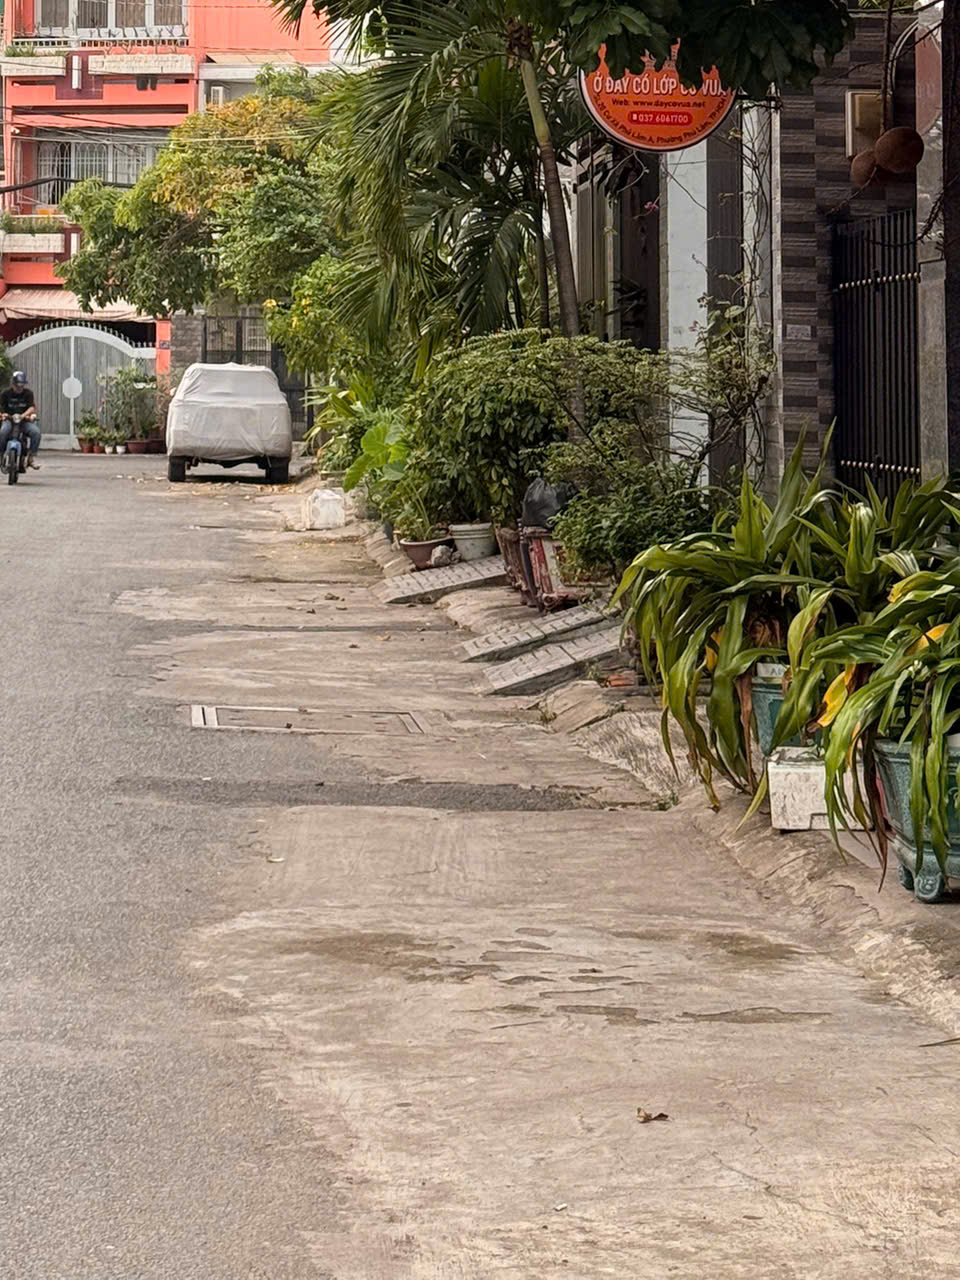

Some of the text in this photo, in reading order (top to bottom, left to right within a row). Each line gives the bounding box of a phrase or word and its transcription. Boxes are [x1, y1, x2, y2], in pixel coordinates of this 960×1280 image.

[593, 72, 603, 93] Ở
[632, 73, 650, 94] CÓ
[653, 73, 677, 95] LỚP
[701, 79, 727, 96] VUA
[638, 113, 689, 123] 037 6061700
